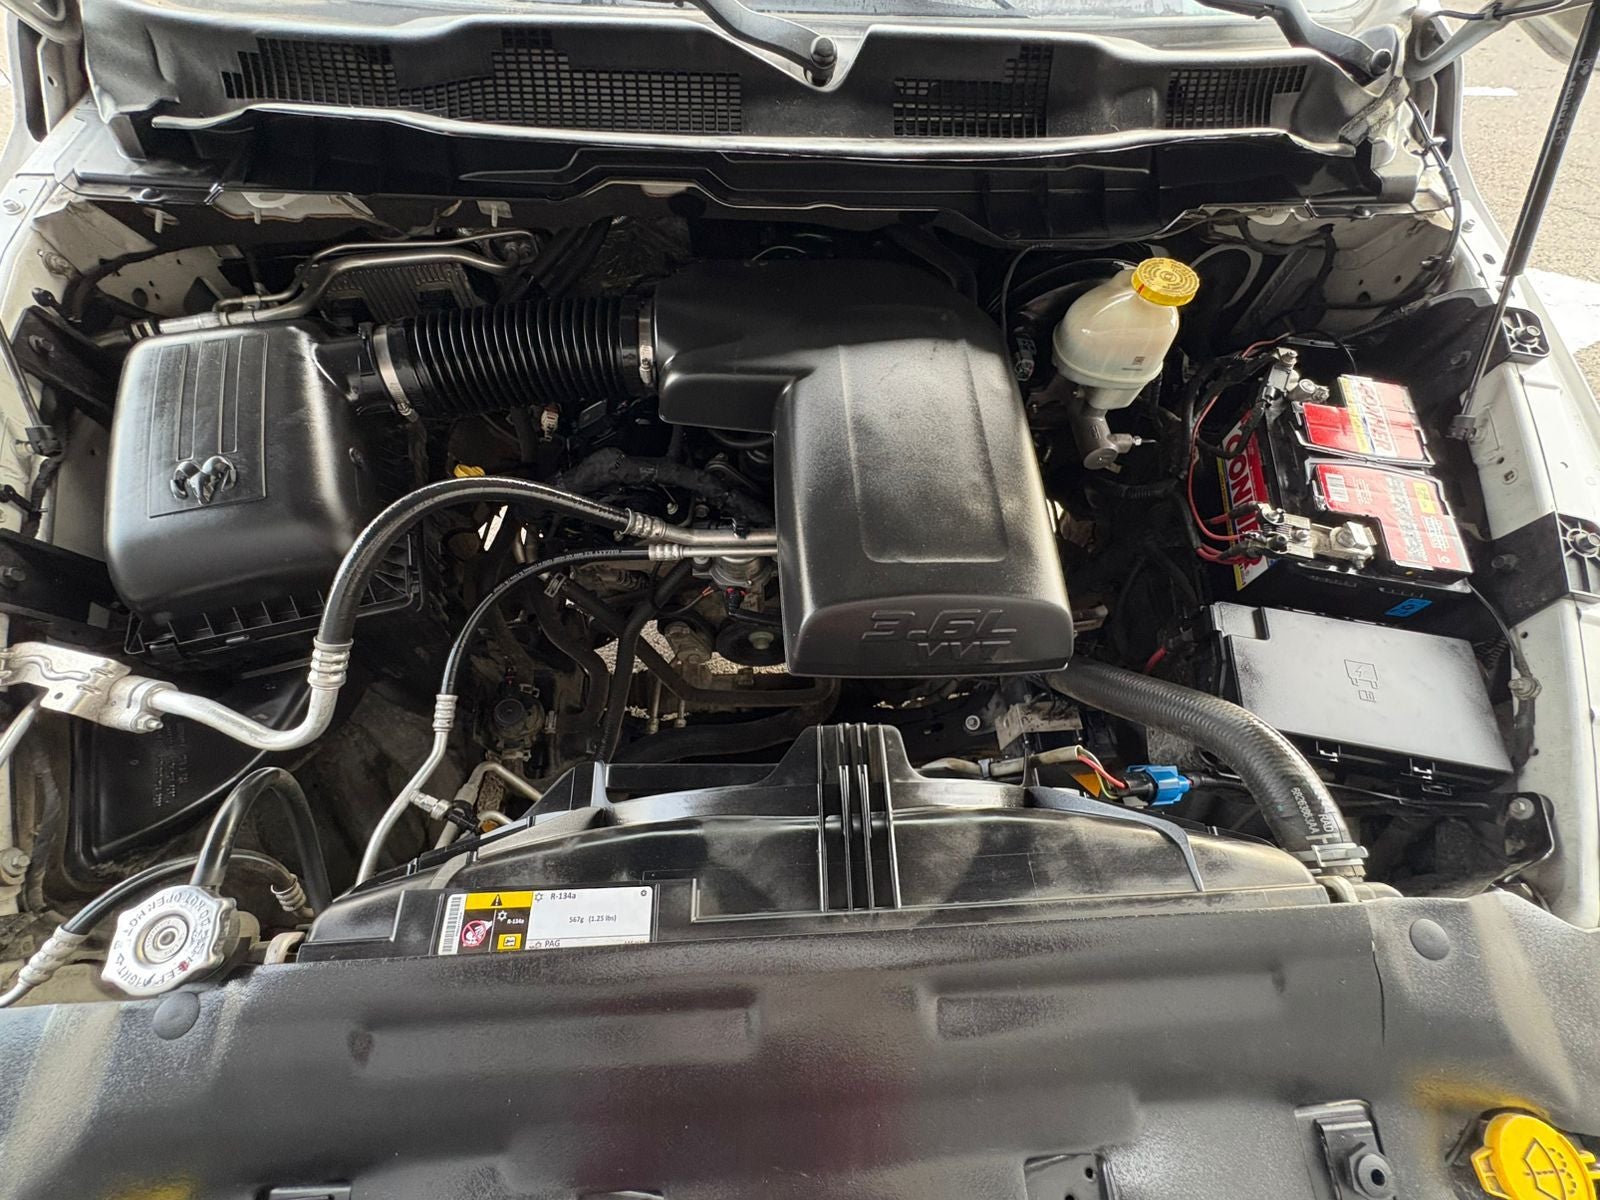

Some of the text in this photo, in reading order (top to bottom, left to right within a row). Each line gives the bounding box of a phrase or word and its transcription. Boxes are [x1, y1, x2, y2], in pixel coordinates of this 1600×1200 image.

[862, 609, 1018, 640] 3.6L
[917, 640, 1012, 660] VVT
[1318, 813, 1334, 832] RAD
[550, 891, 577, 901] R-134a
[568, 913, 617, 924] 567g (1.25 lbs)
[544, 939, 561, 948] PAG
